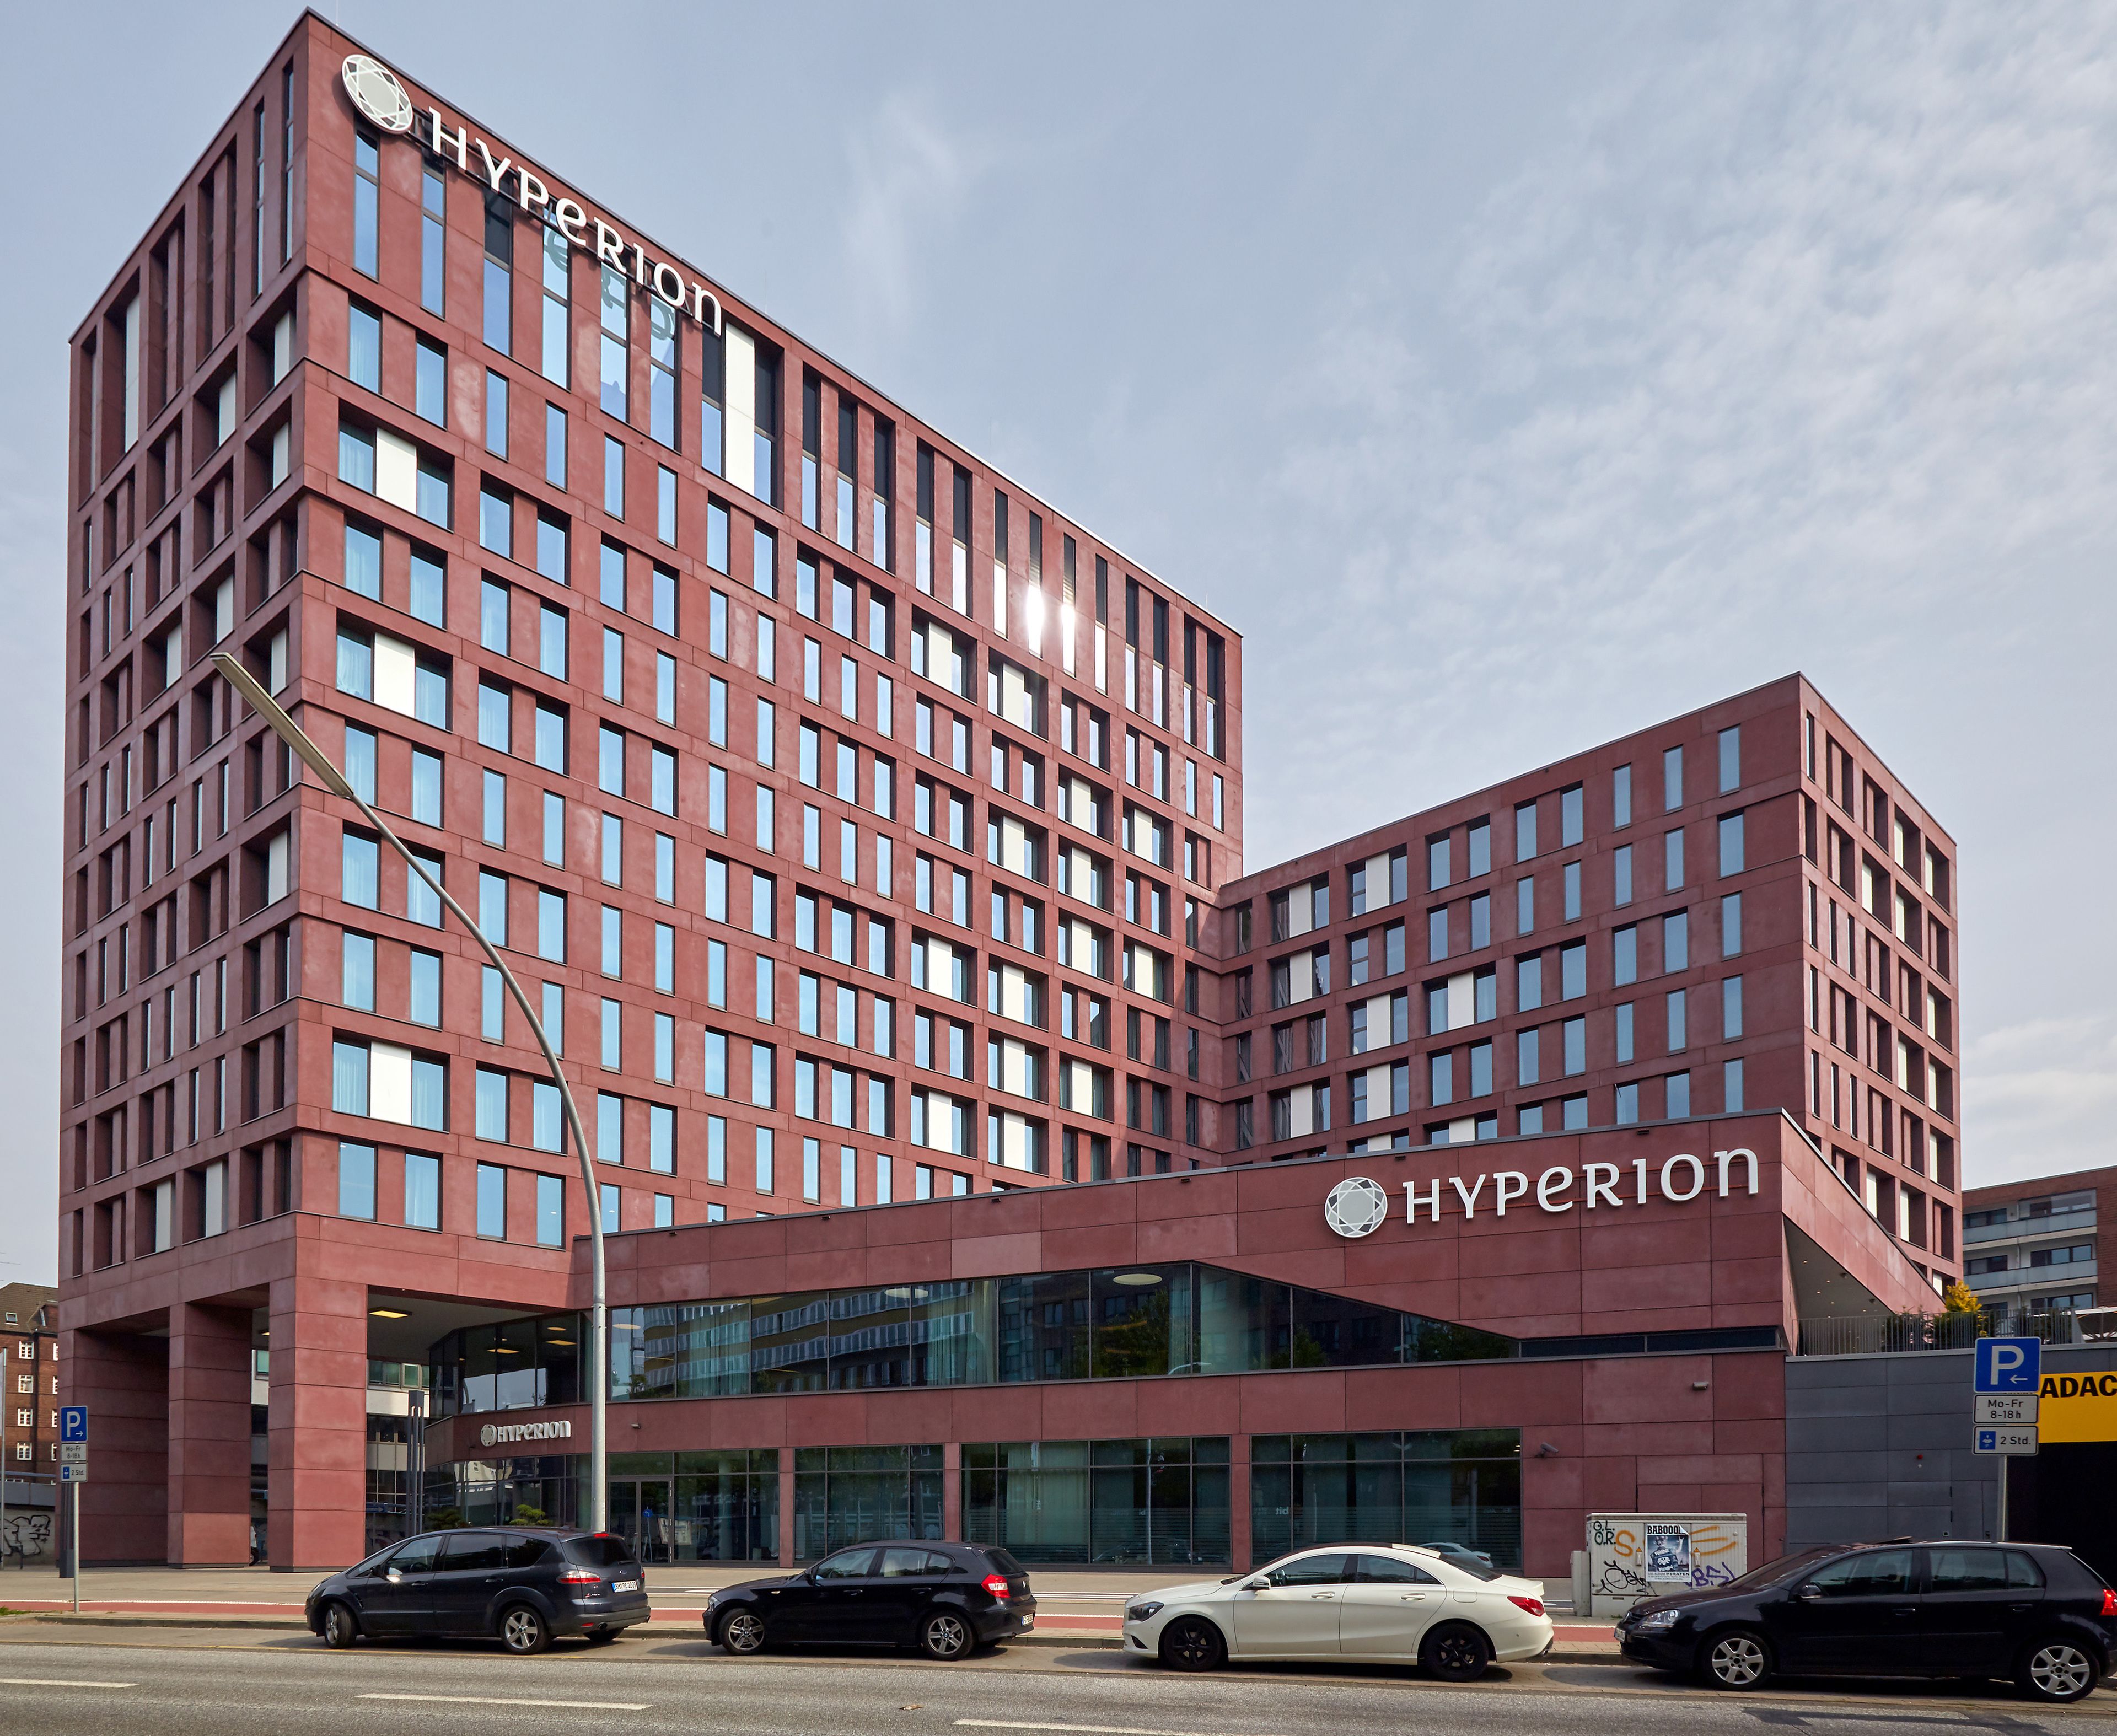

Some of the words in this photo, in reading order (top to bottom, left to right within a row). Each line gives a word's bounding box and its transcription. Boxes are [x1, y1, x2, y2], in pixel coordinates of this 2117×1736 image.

[1990, 1345, 2024, 1385] P
[2040, 1375, 2117, 1398] ADAC
[1987, 1399, 2024, 1407] Mo-Fr
[67, 1411, 81, 1437] P
[2000, 1437, 2006, 1445] 2
[2009, 1436, 2032, 1445] Std.
